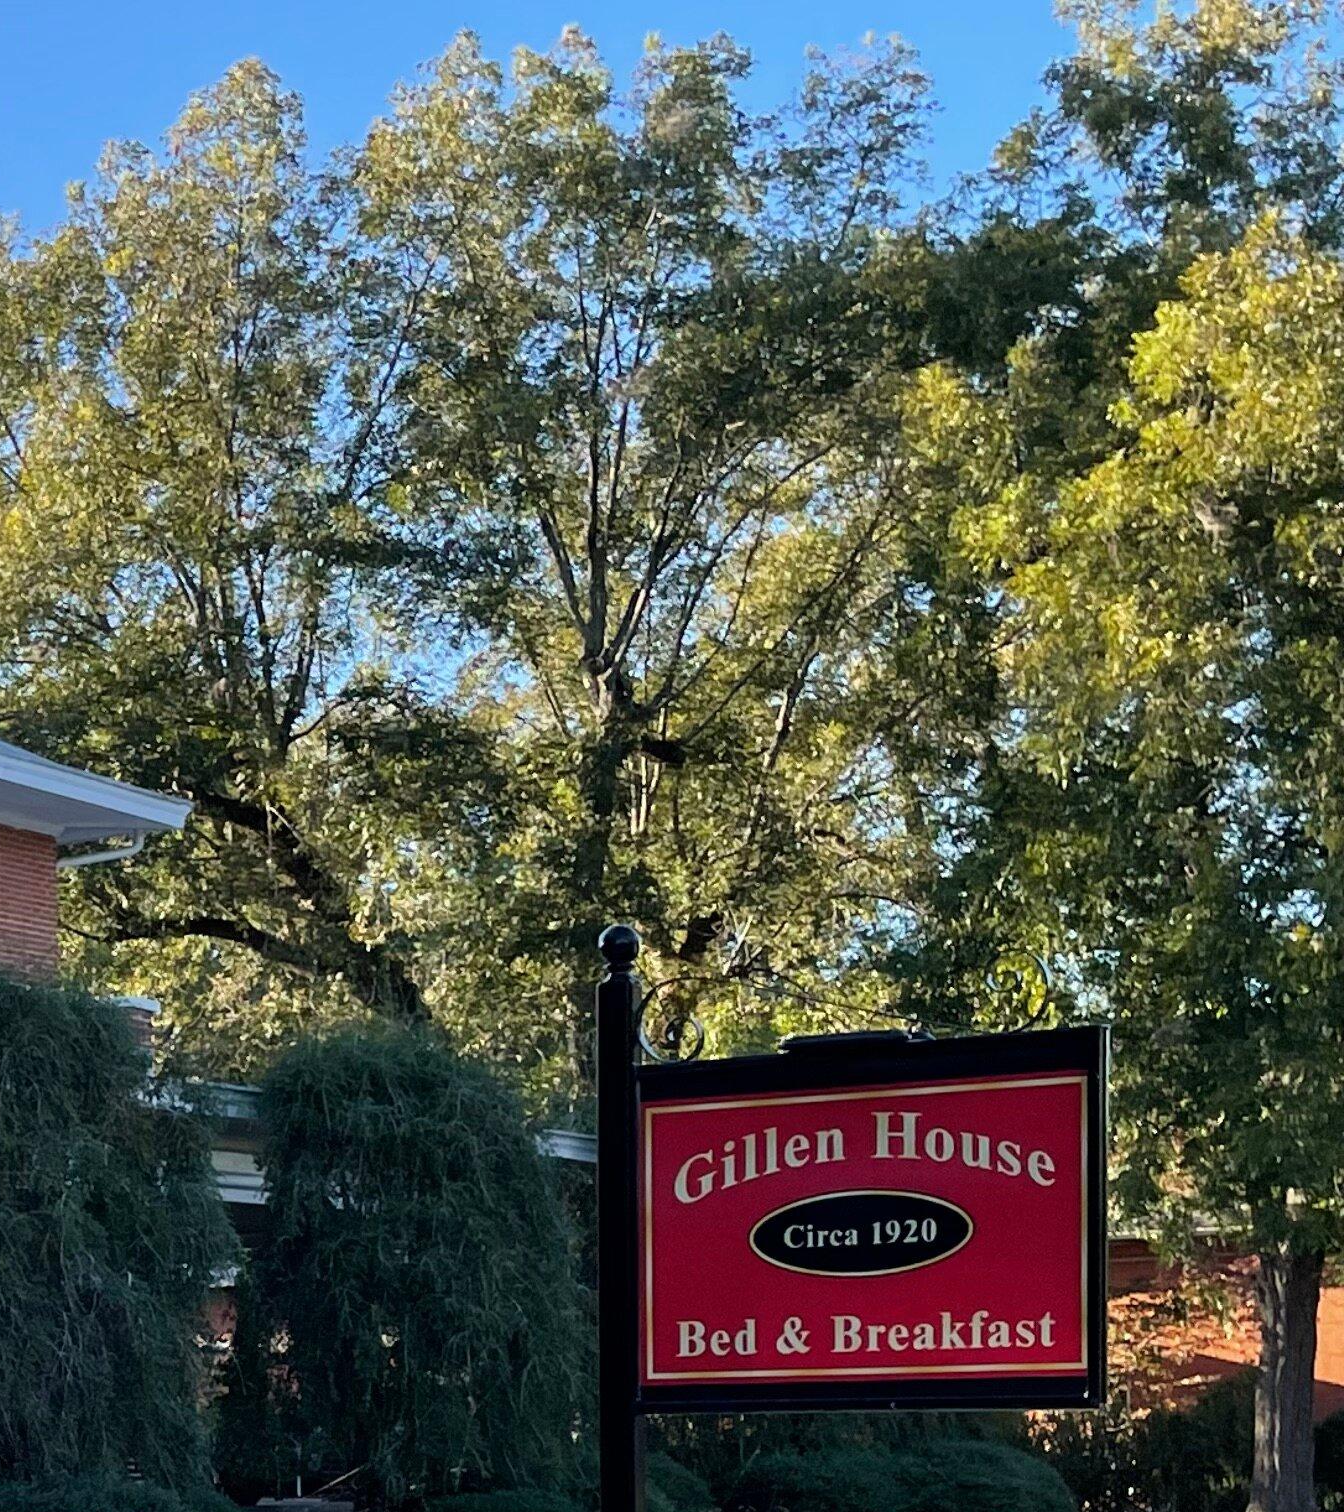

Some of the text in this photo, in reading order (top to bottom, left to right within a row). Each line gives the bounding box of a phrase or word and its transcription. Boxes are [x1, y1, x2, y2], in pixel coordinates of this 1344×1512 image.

[673, 1111, 1056, 1204] Gillen House
[783, 1217, 937, 1249] Circa 1920
[675, 1310, 1056, 1358] Bed & Breakfast
